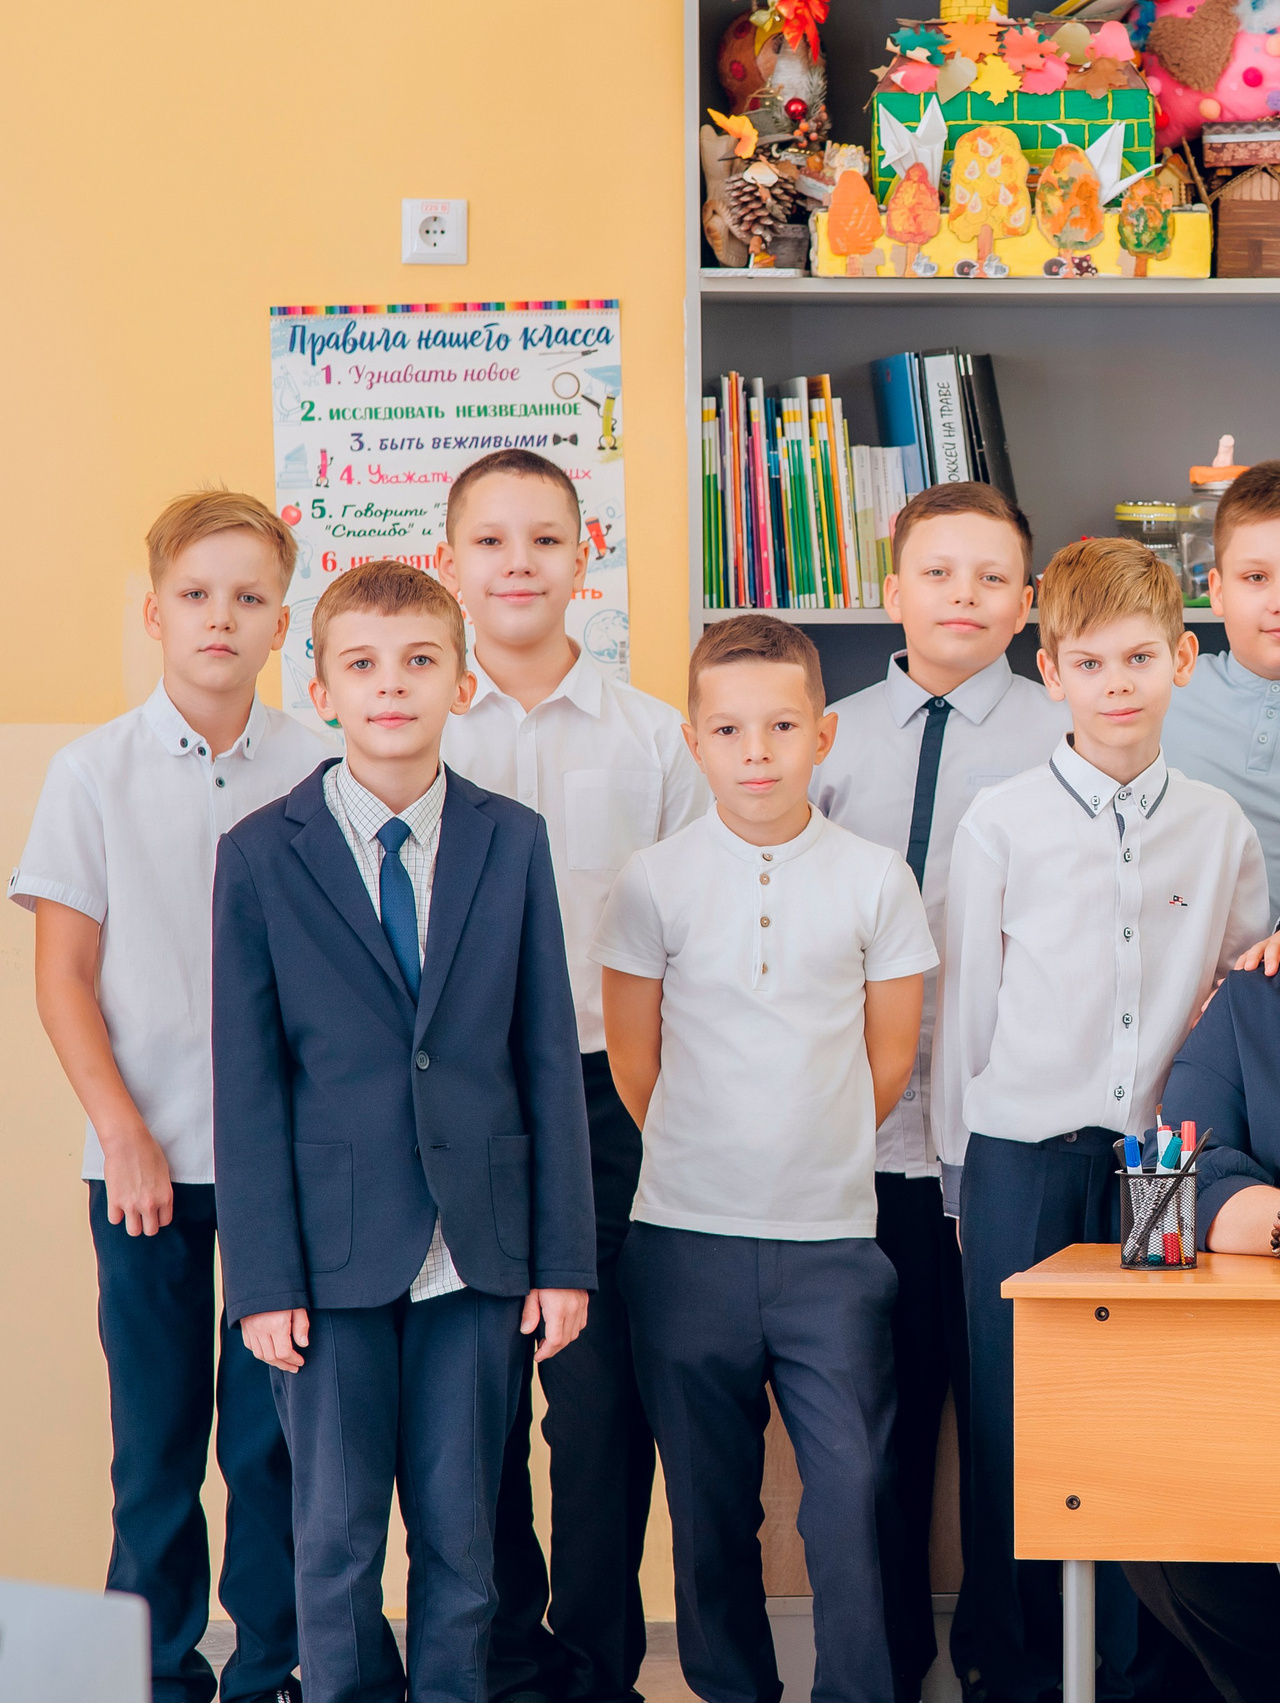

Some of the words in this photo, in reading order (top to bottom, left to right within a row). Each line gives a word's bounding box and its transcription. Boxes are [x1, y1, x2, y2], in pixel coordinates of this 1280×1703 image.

[288, 319, 412, 366] Правила
[418, 321, 512, 352] нашего
[519, 323, 615, 351] класса
[320, 364, 342, 385] 1.
[349, 362, 458, 391] Узнавать
[463, 363, 521, 383] новое
[299, 400, 322, 422] 2.
[328, 404, 445, 421] ИССЛЕДОВАТЬ
[456, 402, 582, 418] НЕИЗВЕДАННОЕ
[936, 381, 954, 419] ТРАВЕ
[942, 421, 956, 437] НА
[350, 433, 372, 452] 3.
[379, 436, 425, 451] БЫТЬ
[431, 433, 548, 450] ВЕЖЛИВЫМИ
[339, 464, 361, 485] 4.
[367, 463, 453, 485] Уважать
[942, 442, 961, 483] ОККЕЙ
[311, 498, 333, 519] 5.
[341, 502, 428, 523] Говорить
[324, 522, 415, 538] "Спасибо"
[421, 527, 434, 536] и
[321, 550, 344, 573] 6.
